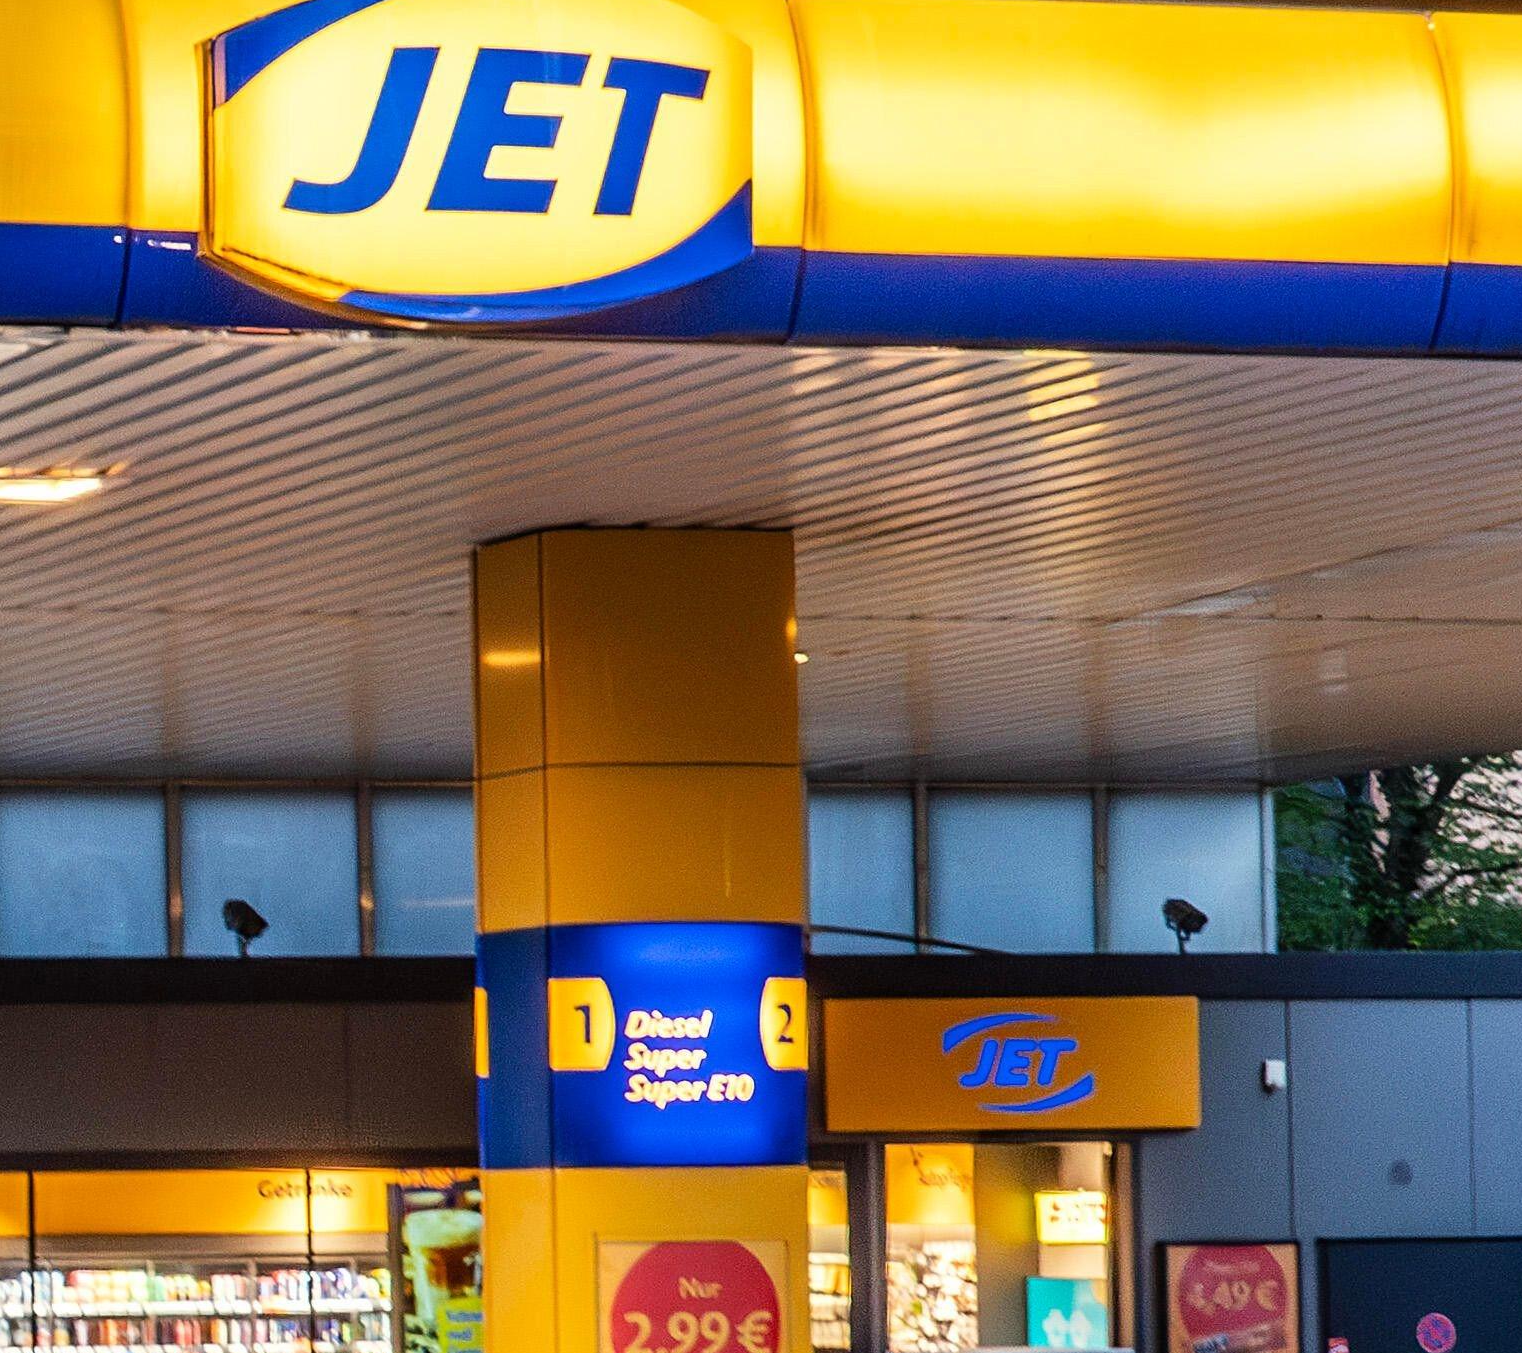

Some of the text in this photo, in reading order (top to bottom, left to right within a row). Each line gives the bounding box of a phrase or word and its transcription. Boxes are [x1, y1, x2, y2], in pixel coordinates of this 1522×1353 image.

[282, 46, 710, 216] JET
[574, 1004, 592, 1044] 1
[624, 1009, 714, 1040] Diesel
[777, 1003, 794, 1043] 2
[623, 1042, 707, 1078] Super
[958, 1037, 1078, 1087] JET
[624, 1073, 755, 1110] Super E10
[257, 1177, 354, 1200] Getrnke
[677, 1276, 722, 1300] Nur
